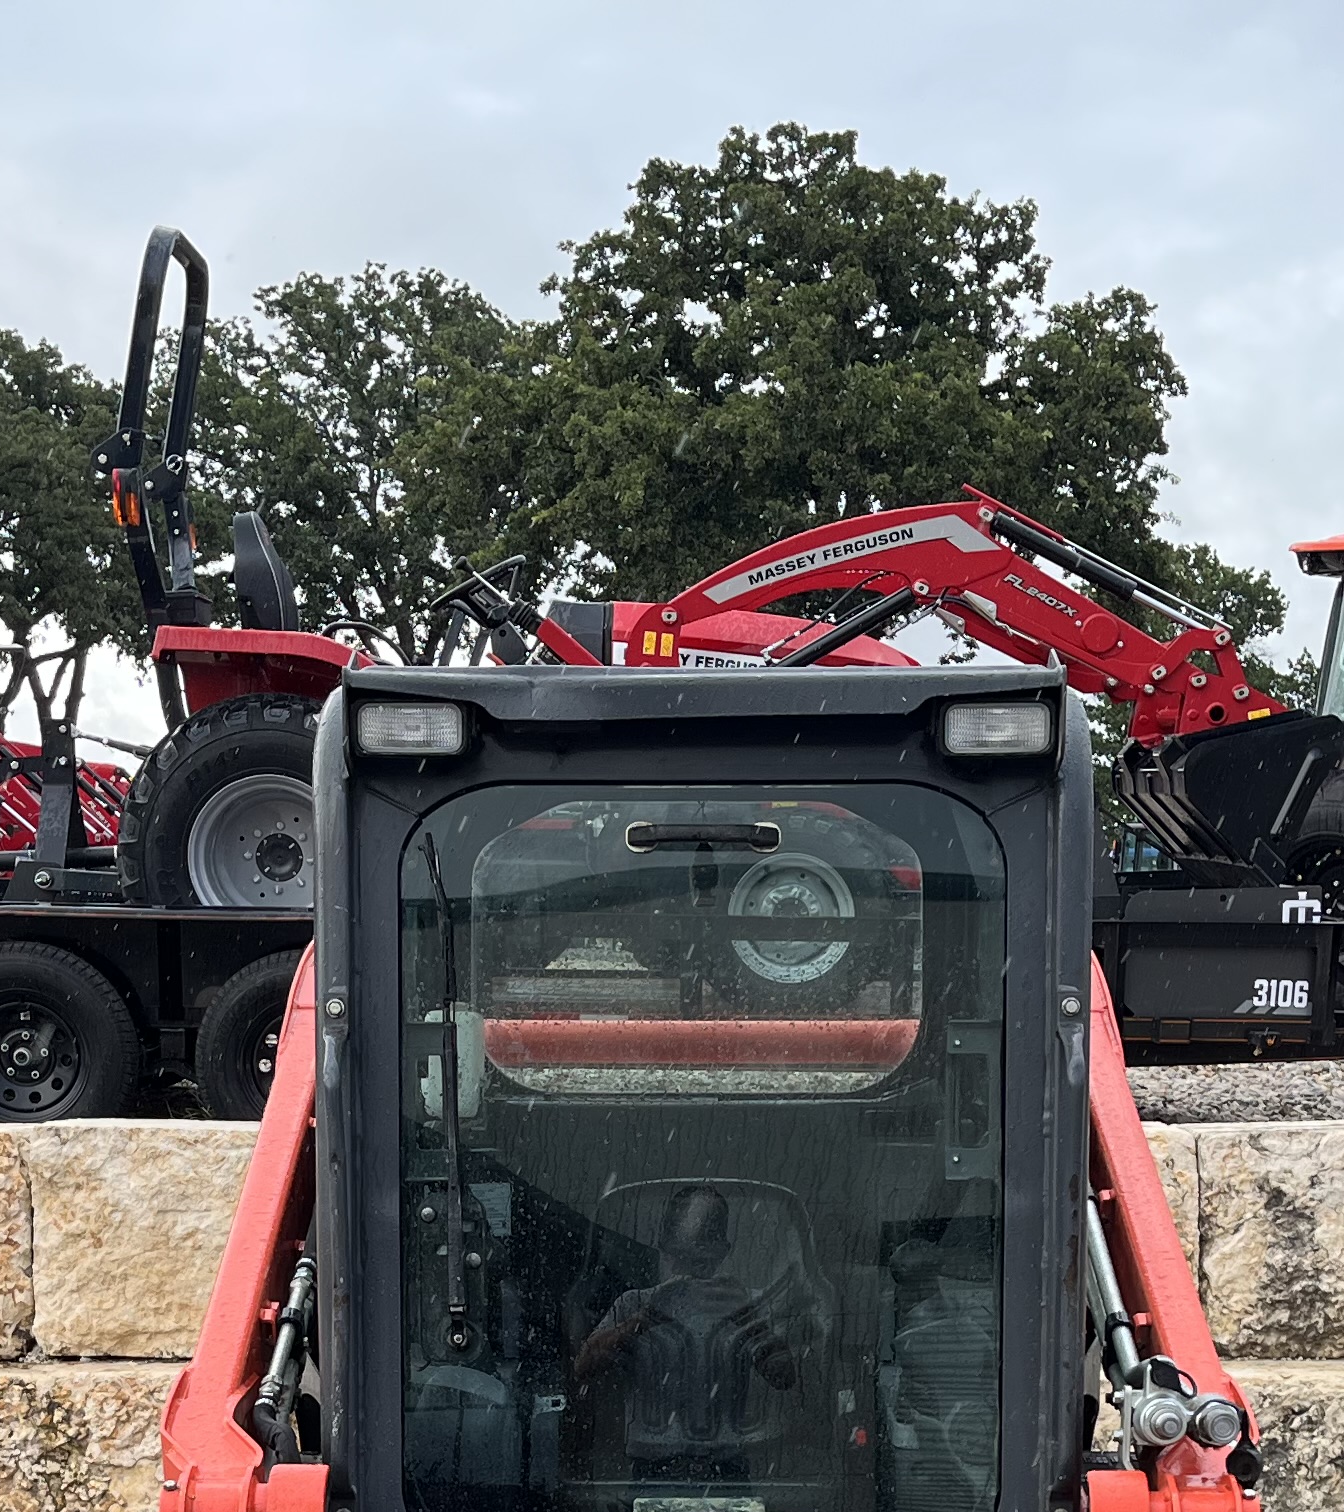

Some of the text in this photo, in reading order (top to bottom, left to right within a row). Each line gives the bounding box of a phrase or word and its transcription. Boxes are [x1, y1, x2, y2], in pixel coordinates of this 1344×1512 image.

[747, 527, 914, 586] MASSEY FERGUSON
[1003, 573, 1077, 617] FL2407X
[694, 655, 766, 668] FERGU
[1252, 978, 1310, 1009] 3106
